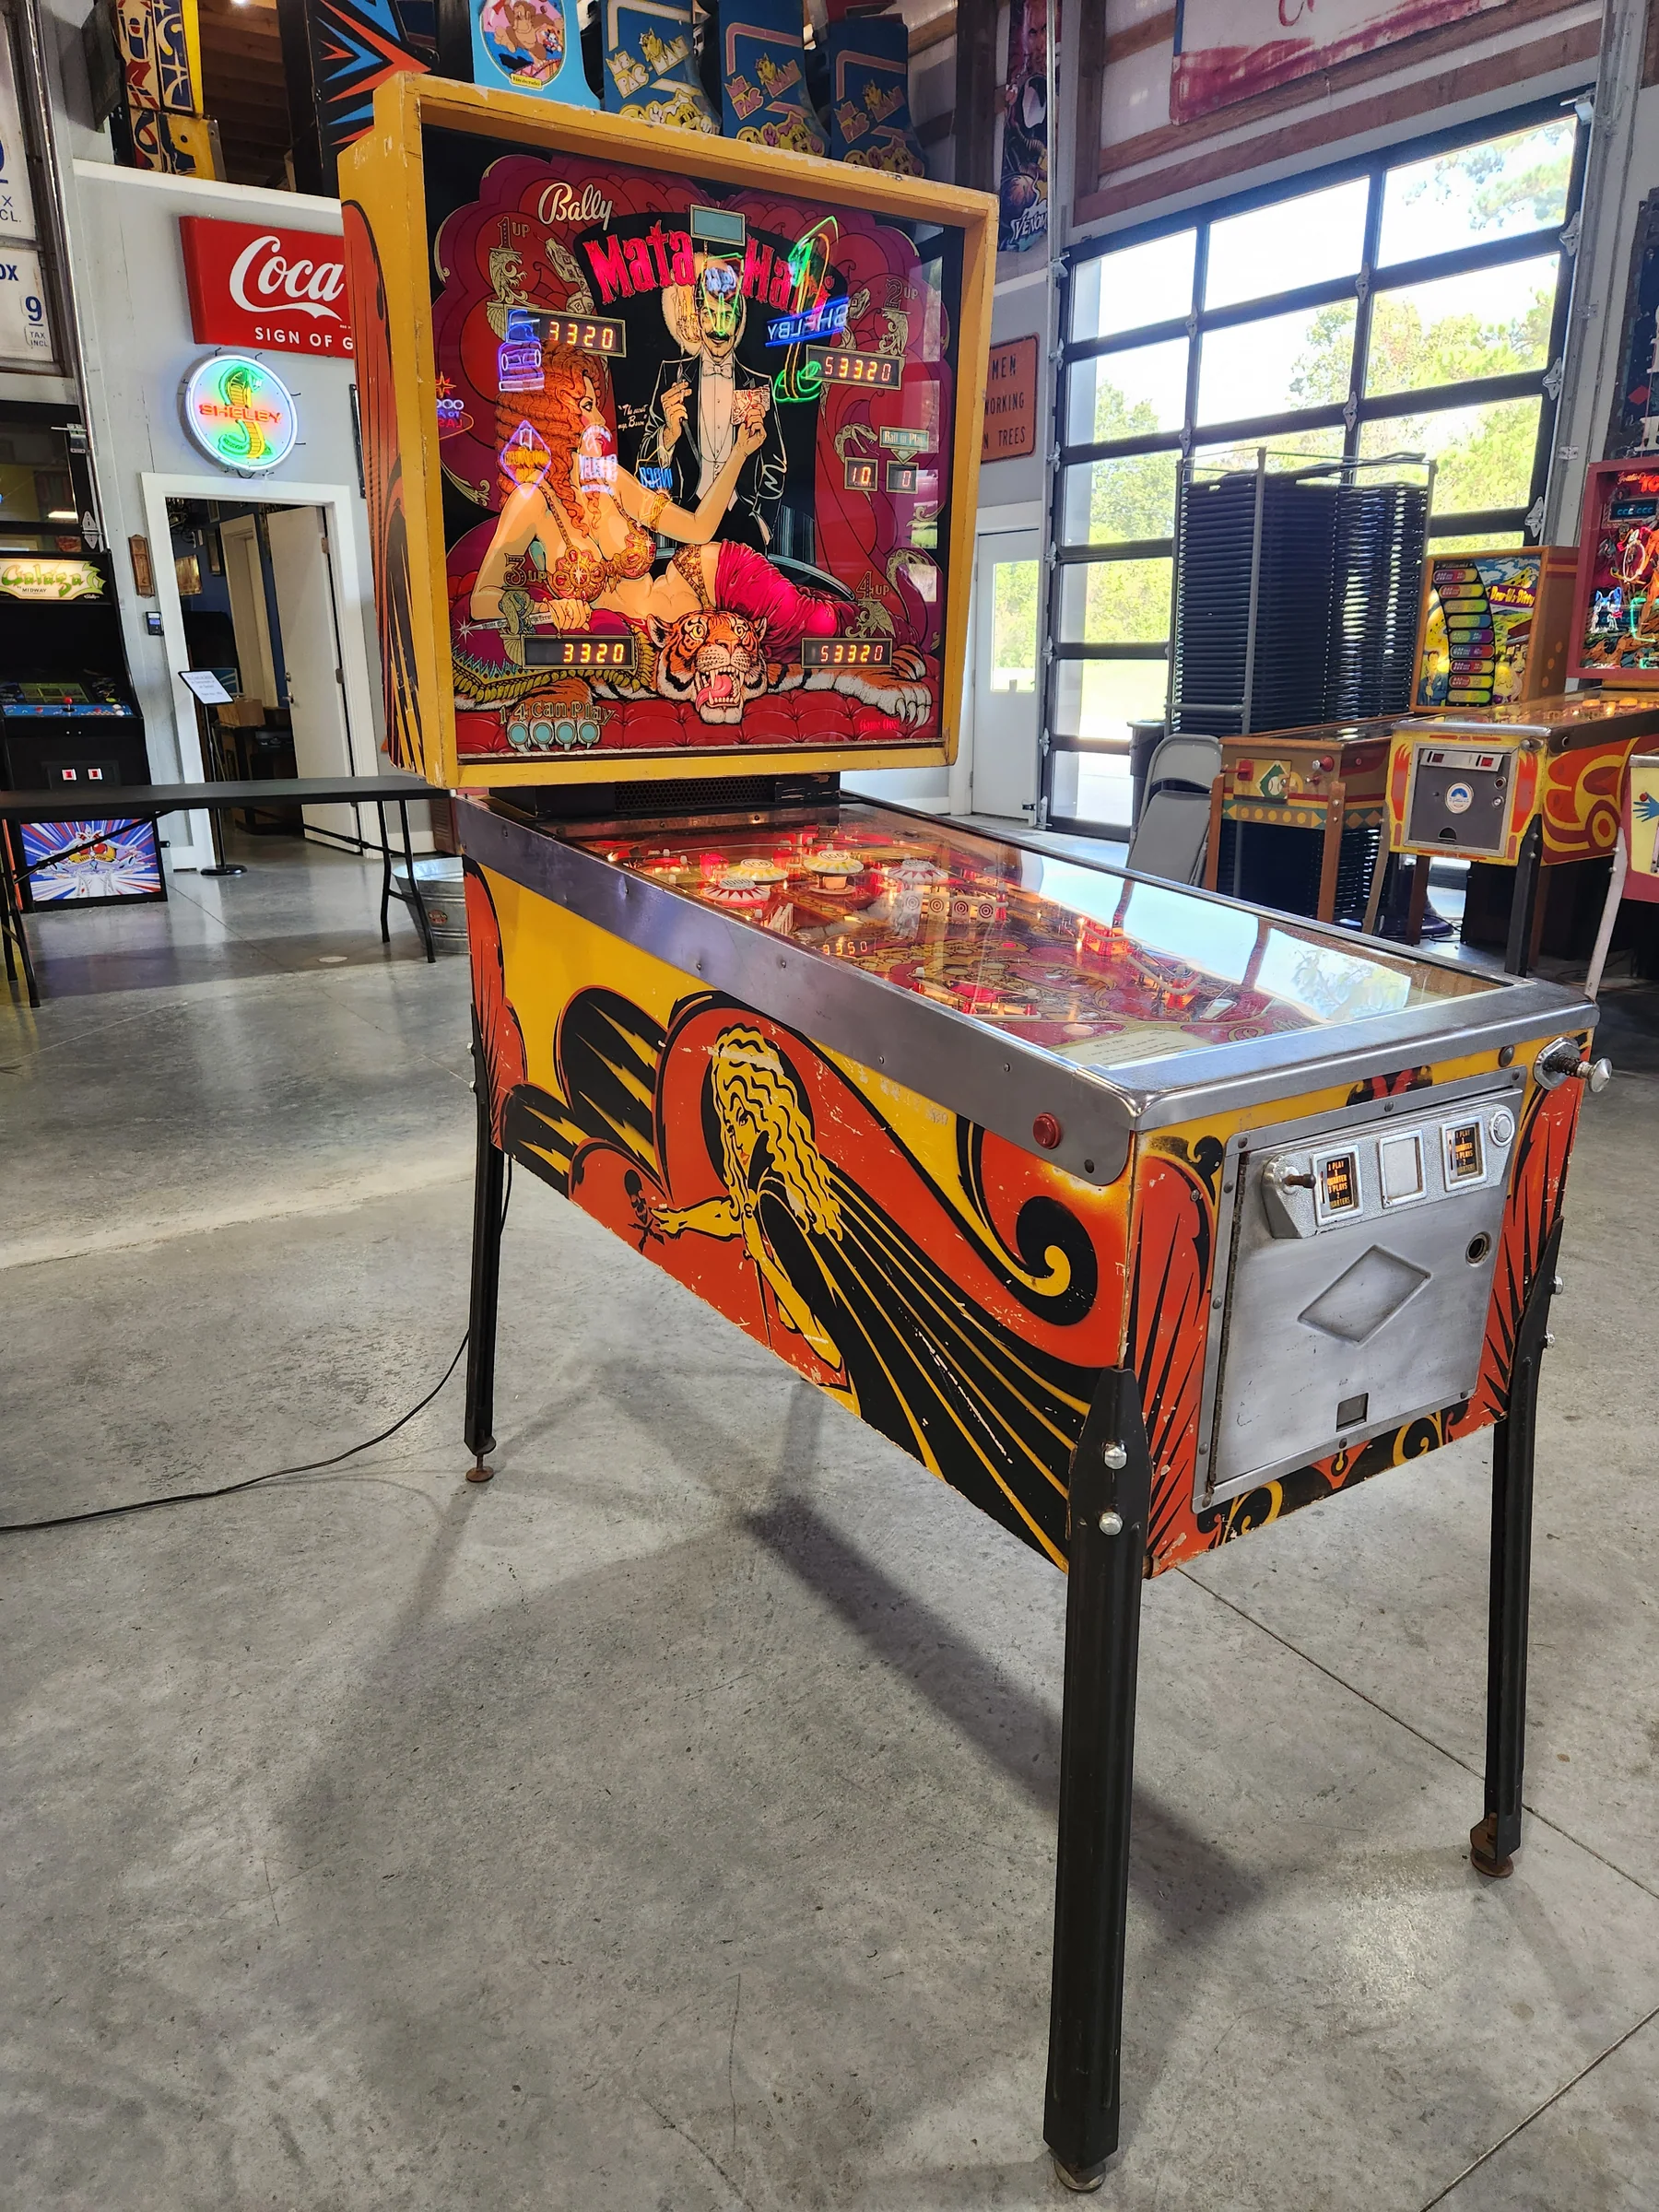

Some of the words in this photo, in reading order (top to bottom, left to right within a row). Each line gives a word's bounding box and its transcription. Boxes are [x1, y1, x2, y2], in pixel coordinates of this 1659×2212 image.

[538, 182, 613, 230] Bally
[582, 219, 696, 305] Mata
[229, 235, 345, 319] Coca
[25, 296, 42, 322] 9
[29, 331, 46, 339] TAX
[254, 326, 300, 345] SIGN
[310, 333, 333, 347] OF
[549, 321, 615, 349] 3320
[825, 356, 892, 382] 53320
[992, 354, 1017, 380] MEN
[198, 404, 282, 423] SHELBY
[998, 426, 1026, 447] TREES
[563, 643, 624, 664] 3320
[820, 644, 883, 664] 53320
[1332, 1160, 1345, 1170] PLAY
[1332, 1182, 1348, 1193] PLAYS
